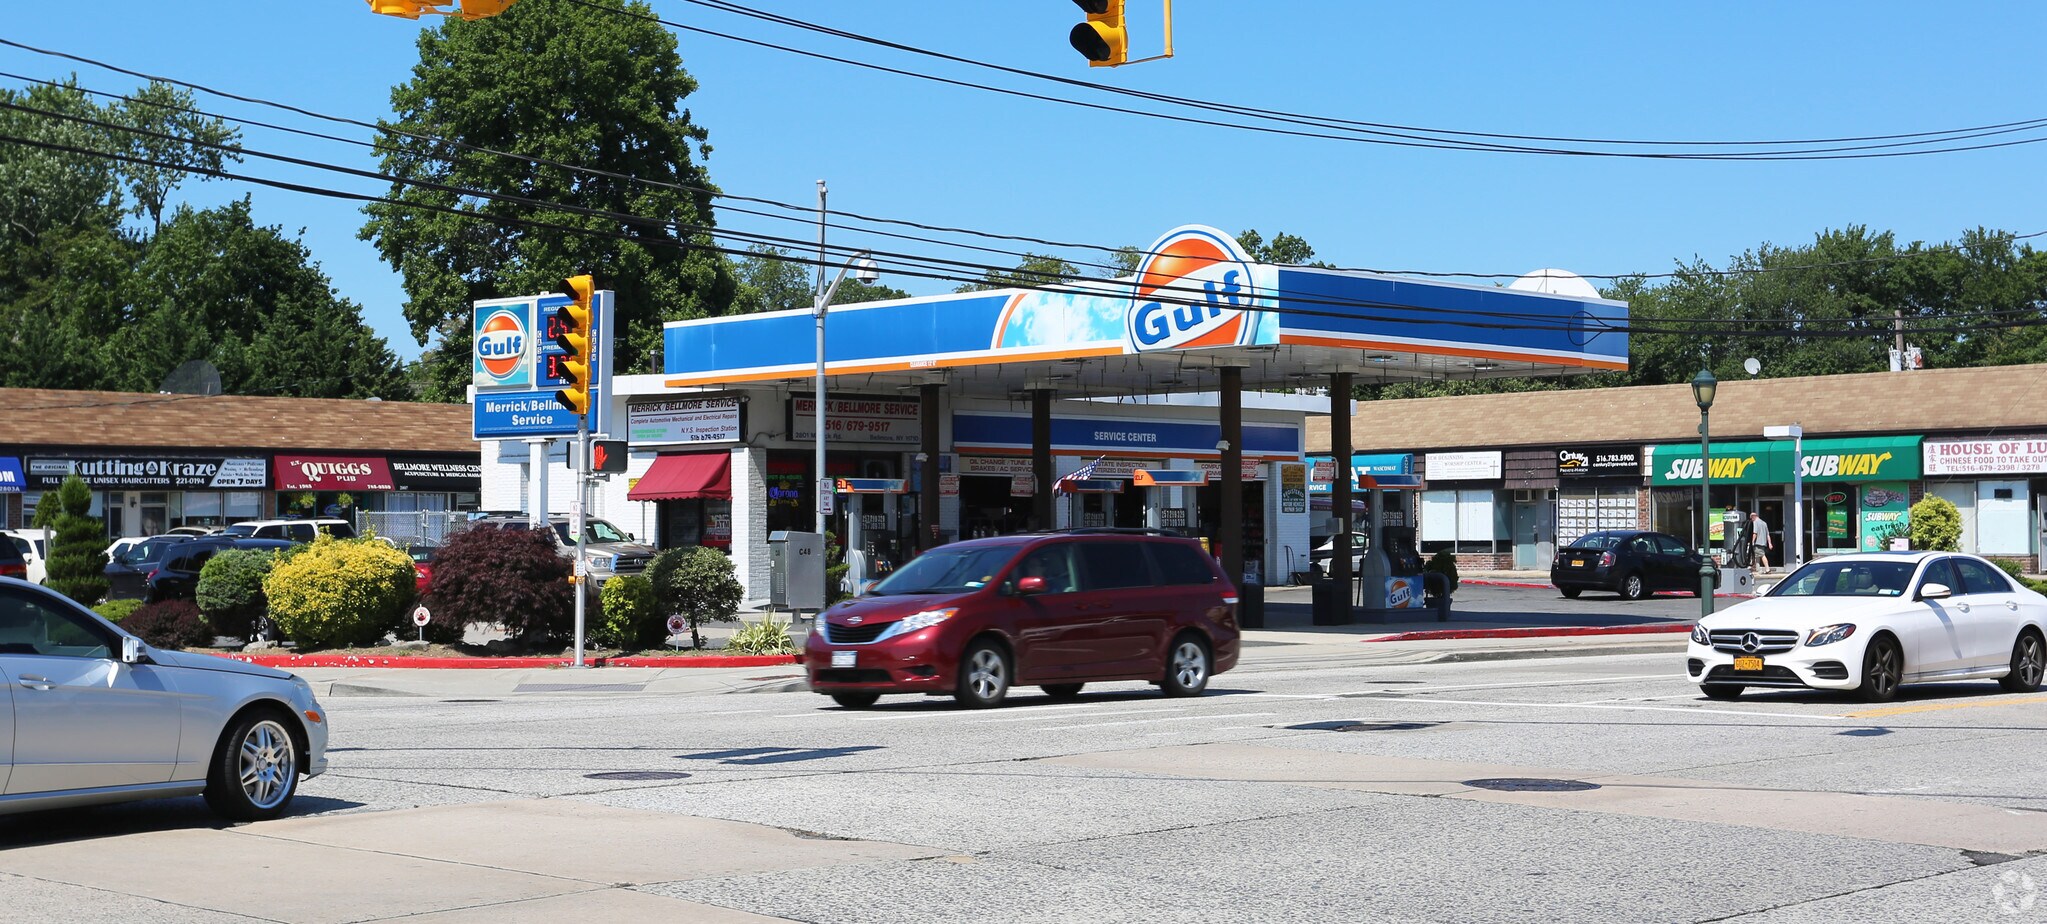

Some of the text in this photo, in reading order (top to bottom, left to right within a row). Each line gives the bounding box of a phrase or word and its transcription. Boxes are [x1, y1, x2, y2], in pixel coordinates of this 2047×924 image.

[1135, 270, 1241, 346] Gulf
[478, 335, 522, 356] Gulf
[706, 399, 737, 410] SERVICE
[884, 403, 918, 416] SERVICE
[512, 415, 553, 426] Service
[695, 425, 720, 434] Inspection
[721, 424, 737, 432] Station
[1094, 431, 1157, 442] SERVICE CENTER
[1940, 443, 1993, 455] HOUSE
[1999, 443, 2021, 454] OF
[1560, 450, 1584, 462] Century
[1940, 456, 1972, 465] CHINESE
[1974, 456, 1995, 464] FOOD
[2009, 455, 2030, 463] TAKE
[70, 460, 216, 477] Kutting Kraze
[393, 463, 431, 471] BELLMORE
[431, 464, 467, 472] WELLNESS
[1665, 456, 1756, 480] SUBWAY
[1796, 451, 1893, 477] SUBWAY
[301, 462, 372, 482] QUIGGS
[238, 478, 244, 486] 7
[1865, 512, 1902, 522] SUBWAY
[1871, 524, 1884, 532] eat
[1390, 588, 1411, 604] Gulf
